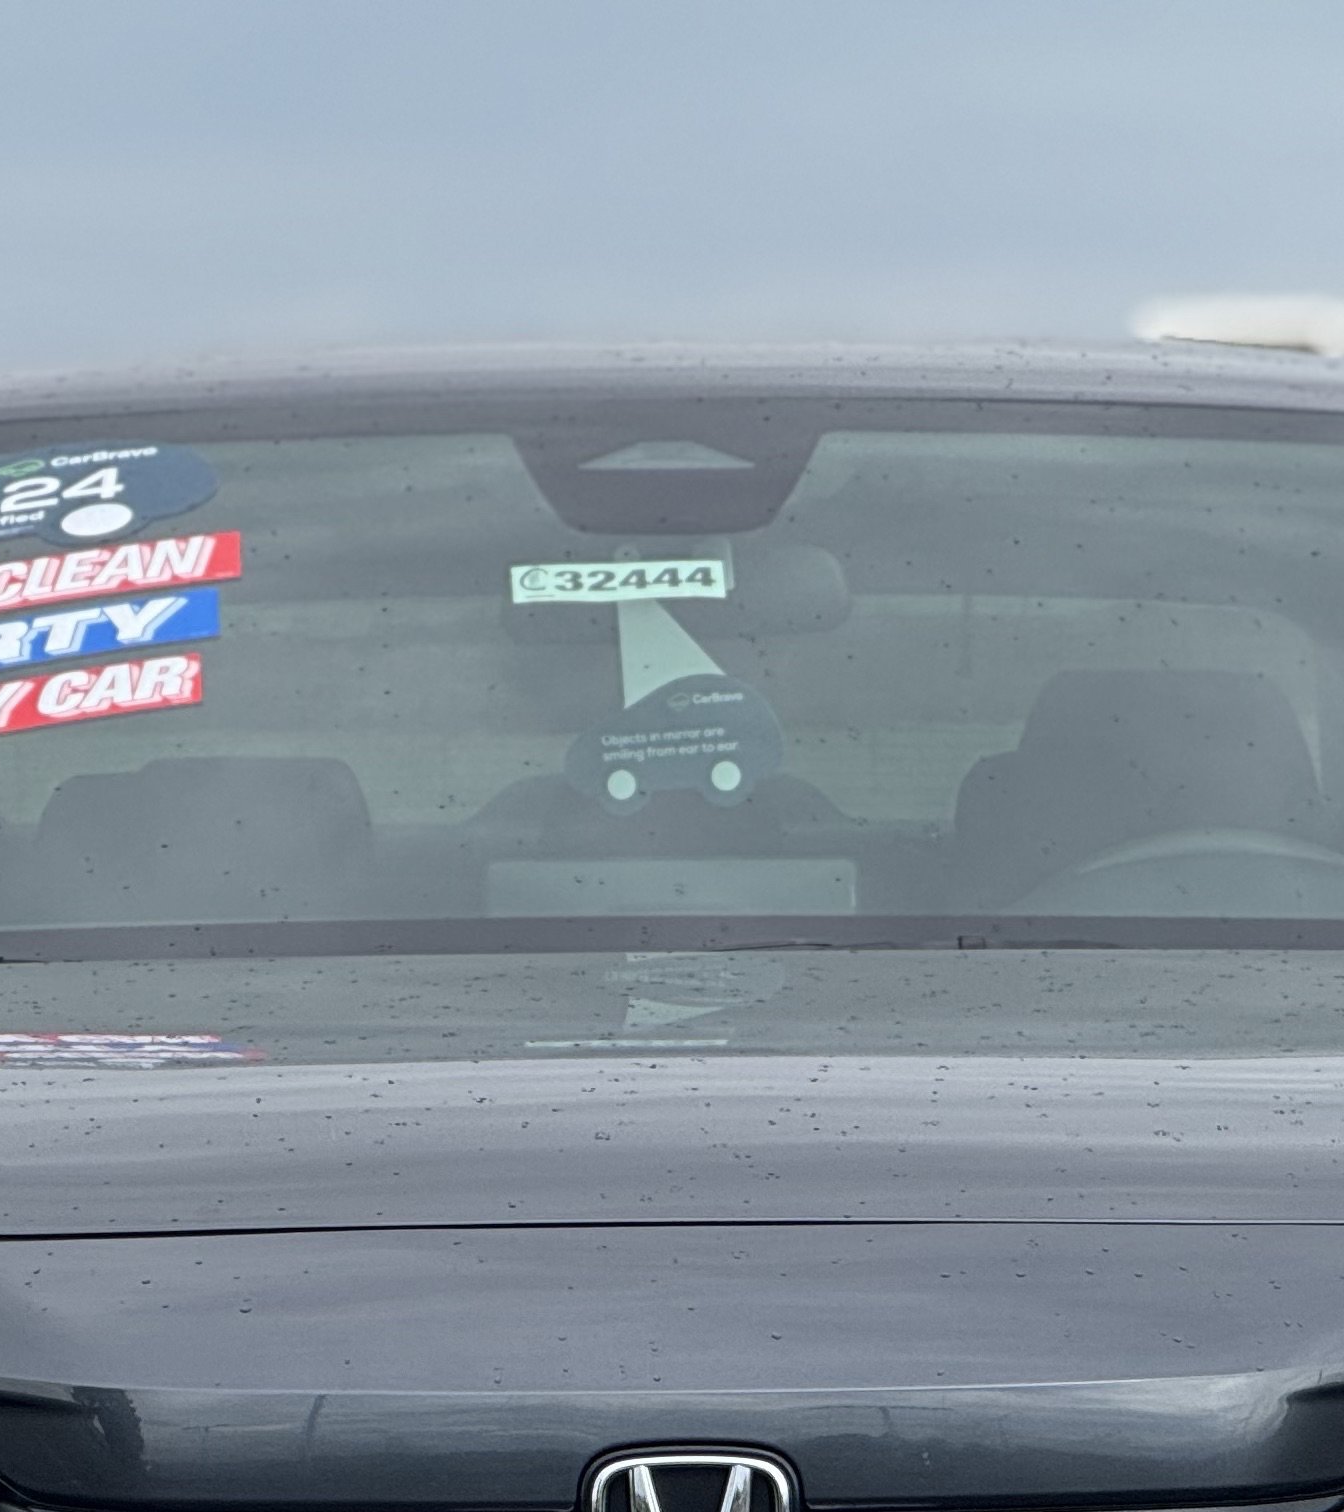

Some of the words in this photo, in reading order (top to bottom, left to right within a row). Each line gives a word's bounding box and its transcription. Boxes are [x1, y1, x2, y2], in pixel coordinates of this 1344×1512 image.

[37, 654, 199, 718] CAR
[601, 735, 647, 748] Objects
[650, 733, 661, 741] in
[663, 730, 701, 741] mirror
[704, 727, 725, 737] are
[602, 750, 645, 762] smiling
[647, 746, 676, 757] from
[679, 745, 699, 755] ear
[702, 742, 715, 752] to
[717, 741, 738, 751] ear
